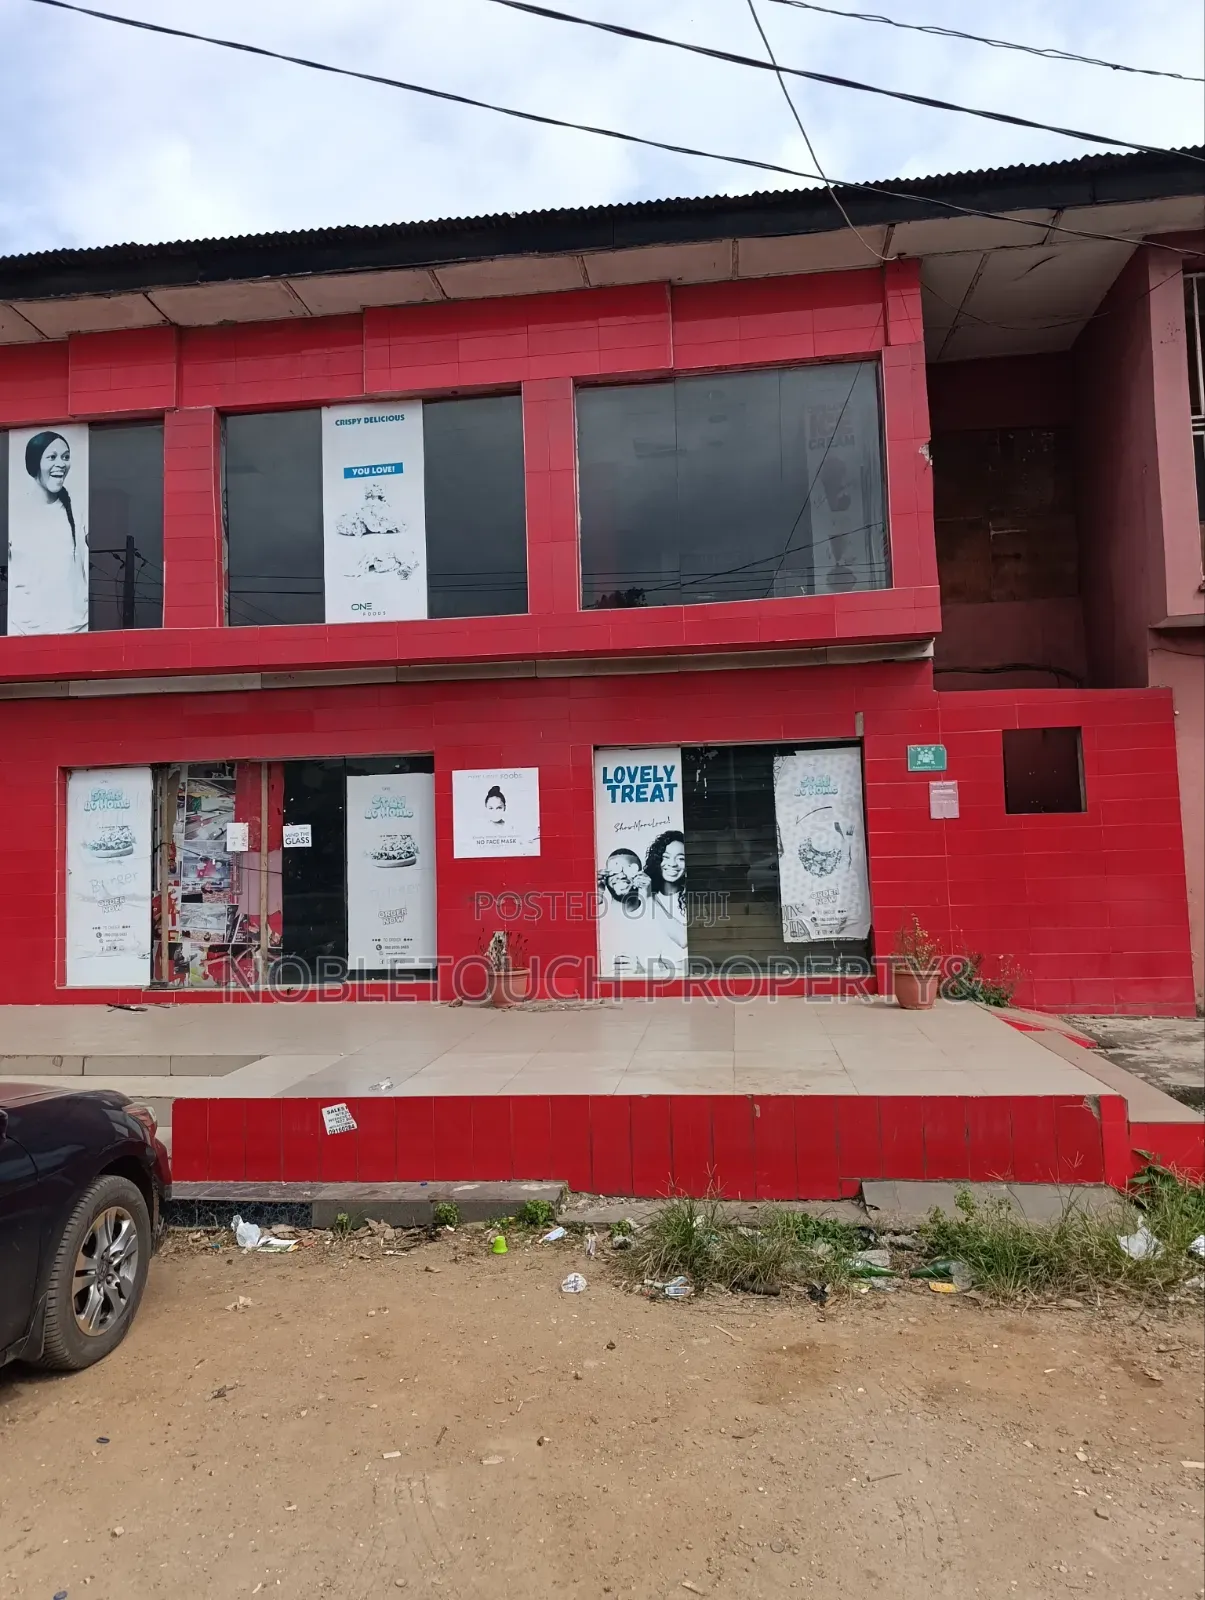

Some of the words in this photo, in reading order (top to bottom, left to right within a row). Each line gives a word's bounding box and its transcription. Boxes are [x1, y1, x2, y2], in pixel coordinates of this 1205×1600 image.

[335, 418, 361, 426] CRISPY
[364, 414, 405, 424] DELICIOUS
[352, 467, 369, 475] YOU
[372, 466, 395, 474] LOVE!
[351, 602, 372, 610] ONE
[602, 764, 675, 784] LOVELY
[606, 783, 678, 803] TREAT
[285, 836, 310, 845] GLASS
